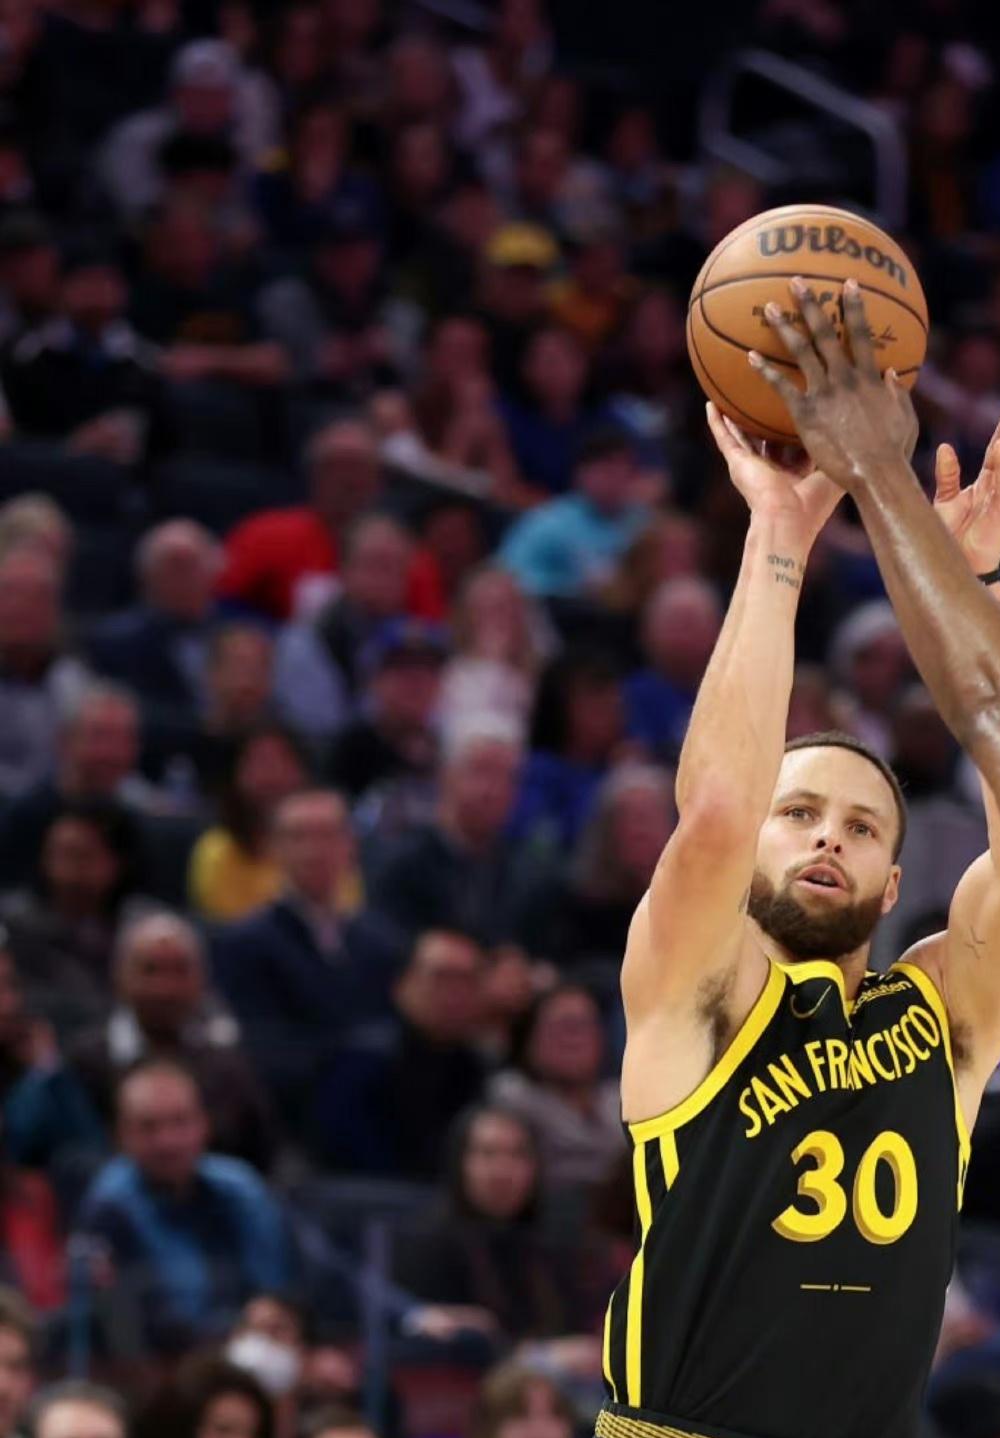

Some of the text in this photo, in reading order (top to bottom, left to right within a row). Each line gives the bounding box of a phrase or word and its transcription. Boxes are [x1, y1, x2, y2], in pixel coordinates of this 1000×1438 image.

[757, 223, 908, 289] Wilson
[739, 1053, 813, 1138] SAN
[770, 1129, 919, 1246] 30
